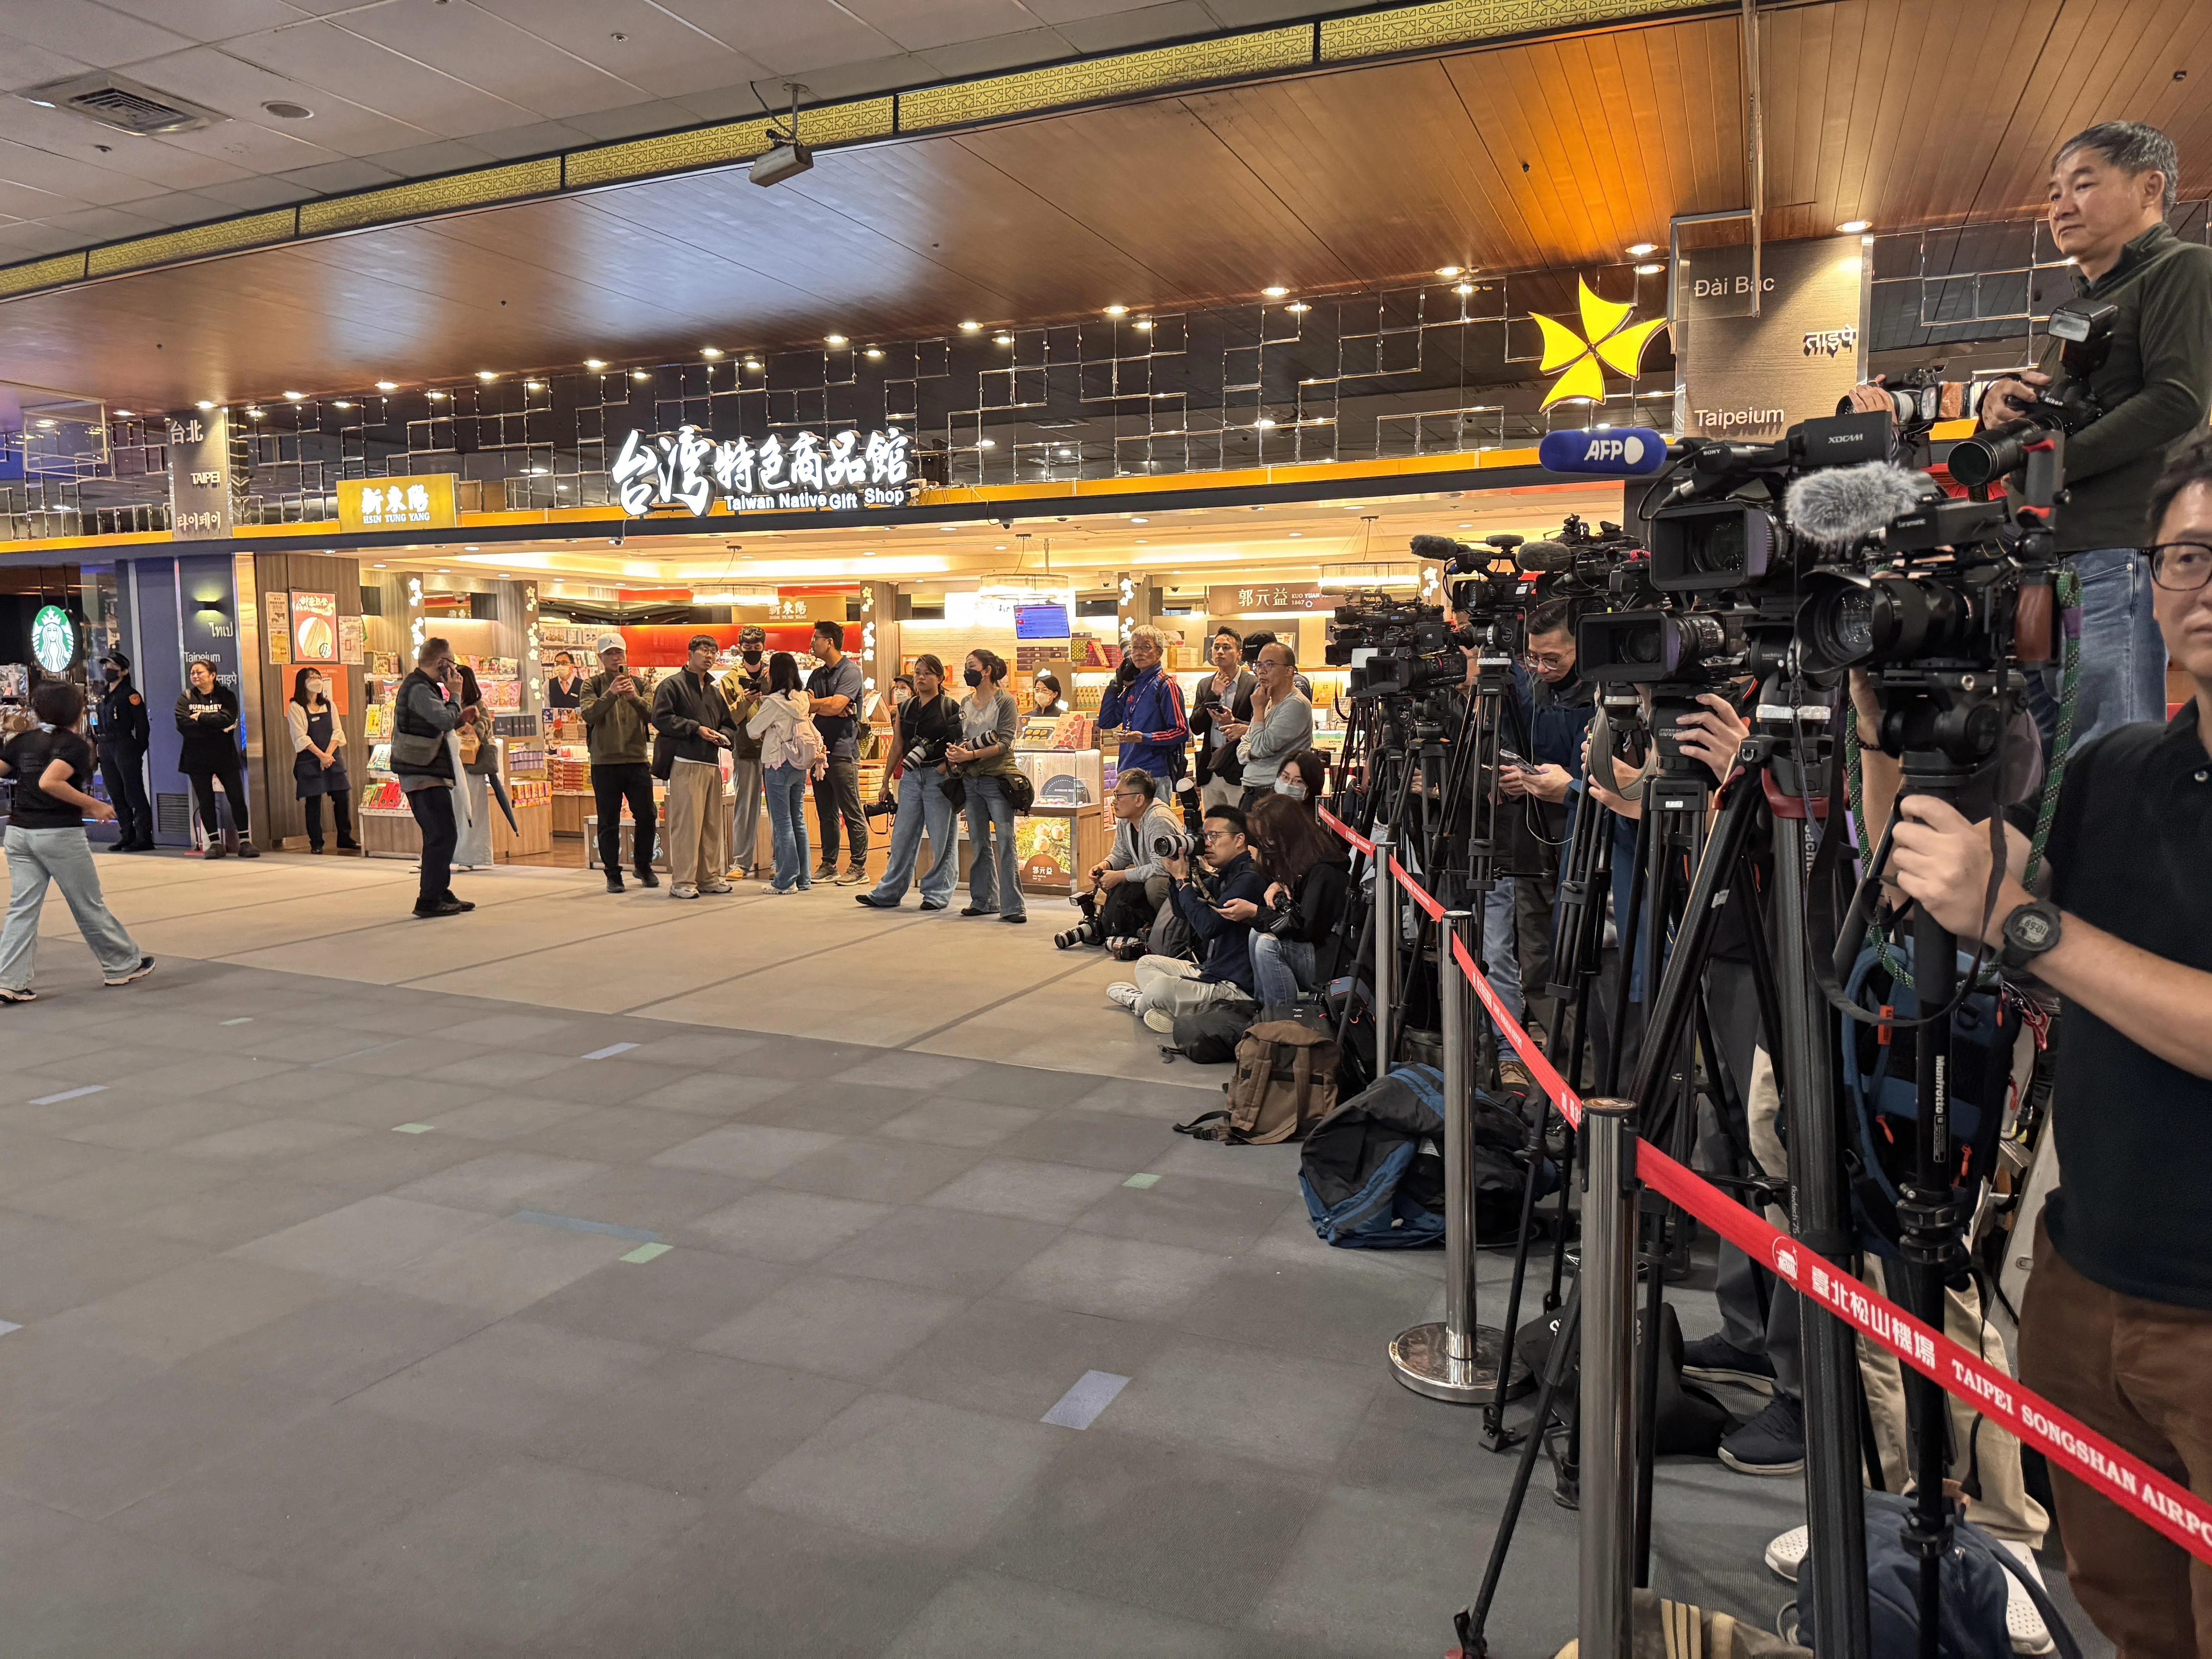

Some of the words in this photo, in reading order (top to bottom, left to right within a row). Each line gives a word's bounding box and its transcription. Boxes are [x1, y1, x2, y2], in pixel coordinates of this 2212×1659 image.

[1693, 278, 1728, 297] Đài
[1805, 324, 1856, 350] ताइपे
[2044, 397, 2063, 406] Nikon
[1694, 407, 1784, 429] Taipeium
[170, 419, 203, 445] 台北
[1828, 433, 1863, 444] XDCAM
[1584, 440, 1624, 460] AFP
[191, 471, 220, 484] TAIPEI
[361, 484, 429, 514] 新東陽
[724, 495, 774, 511] Taiwan
[779, 493, 827, 508] Native
[829, 493, 858, 510] Gift
[864, 488, 904, 506] Shop
[177, 511, 221, 531] 타이페이
[363, 515, 382, 524] HSIN
[384, 514, 406, 523] TUNG
[409, 512, 430, 522] YANG
[1897, 518, 1926, 528] Saramonic
[1238, 587, 1288, 607] 郭元益
[769, 601, 807, 615] 新東陽
[208, 622, 233, 637] ไทเป
[1936, 1056, 1945, 1114] Manfrotto
[1793, 1222, 1799, 1234] 75
[1812, 1264, 1936, 1369] 臺北松山機場
[1952, 1359, 2015, 1416] TAIPEI
[2021, 1406, 2137, 1496] SONGSHAN
